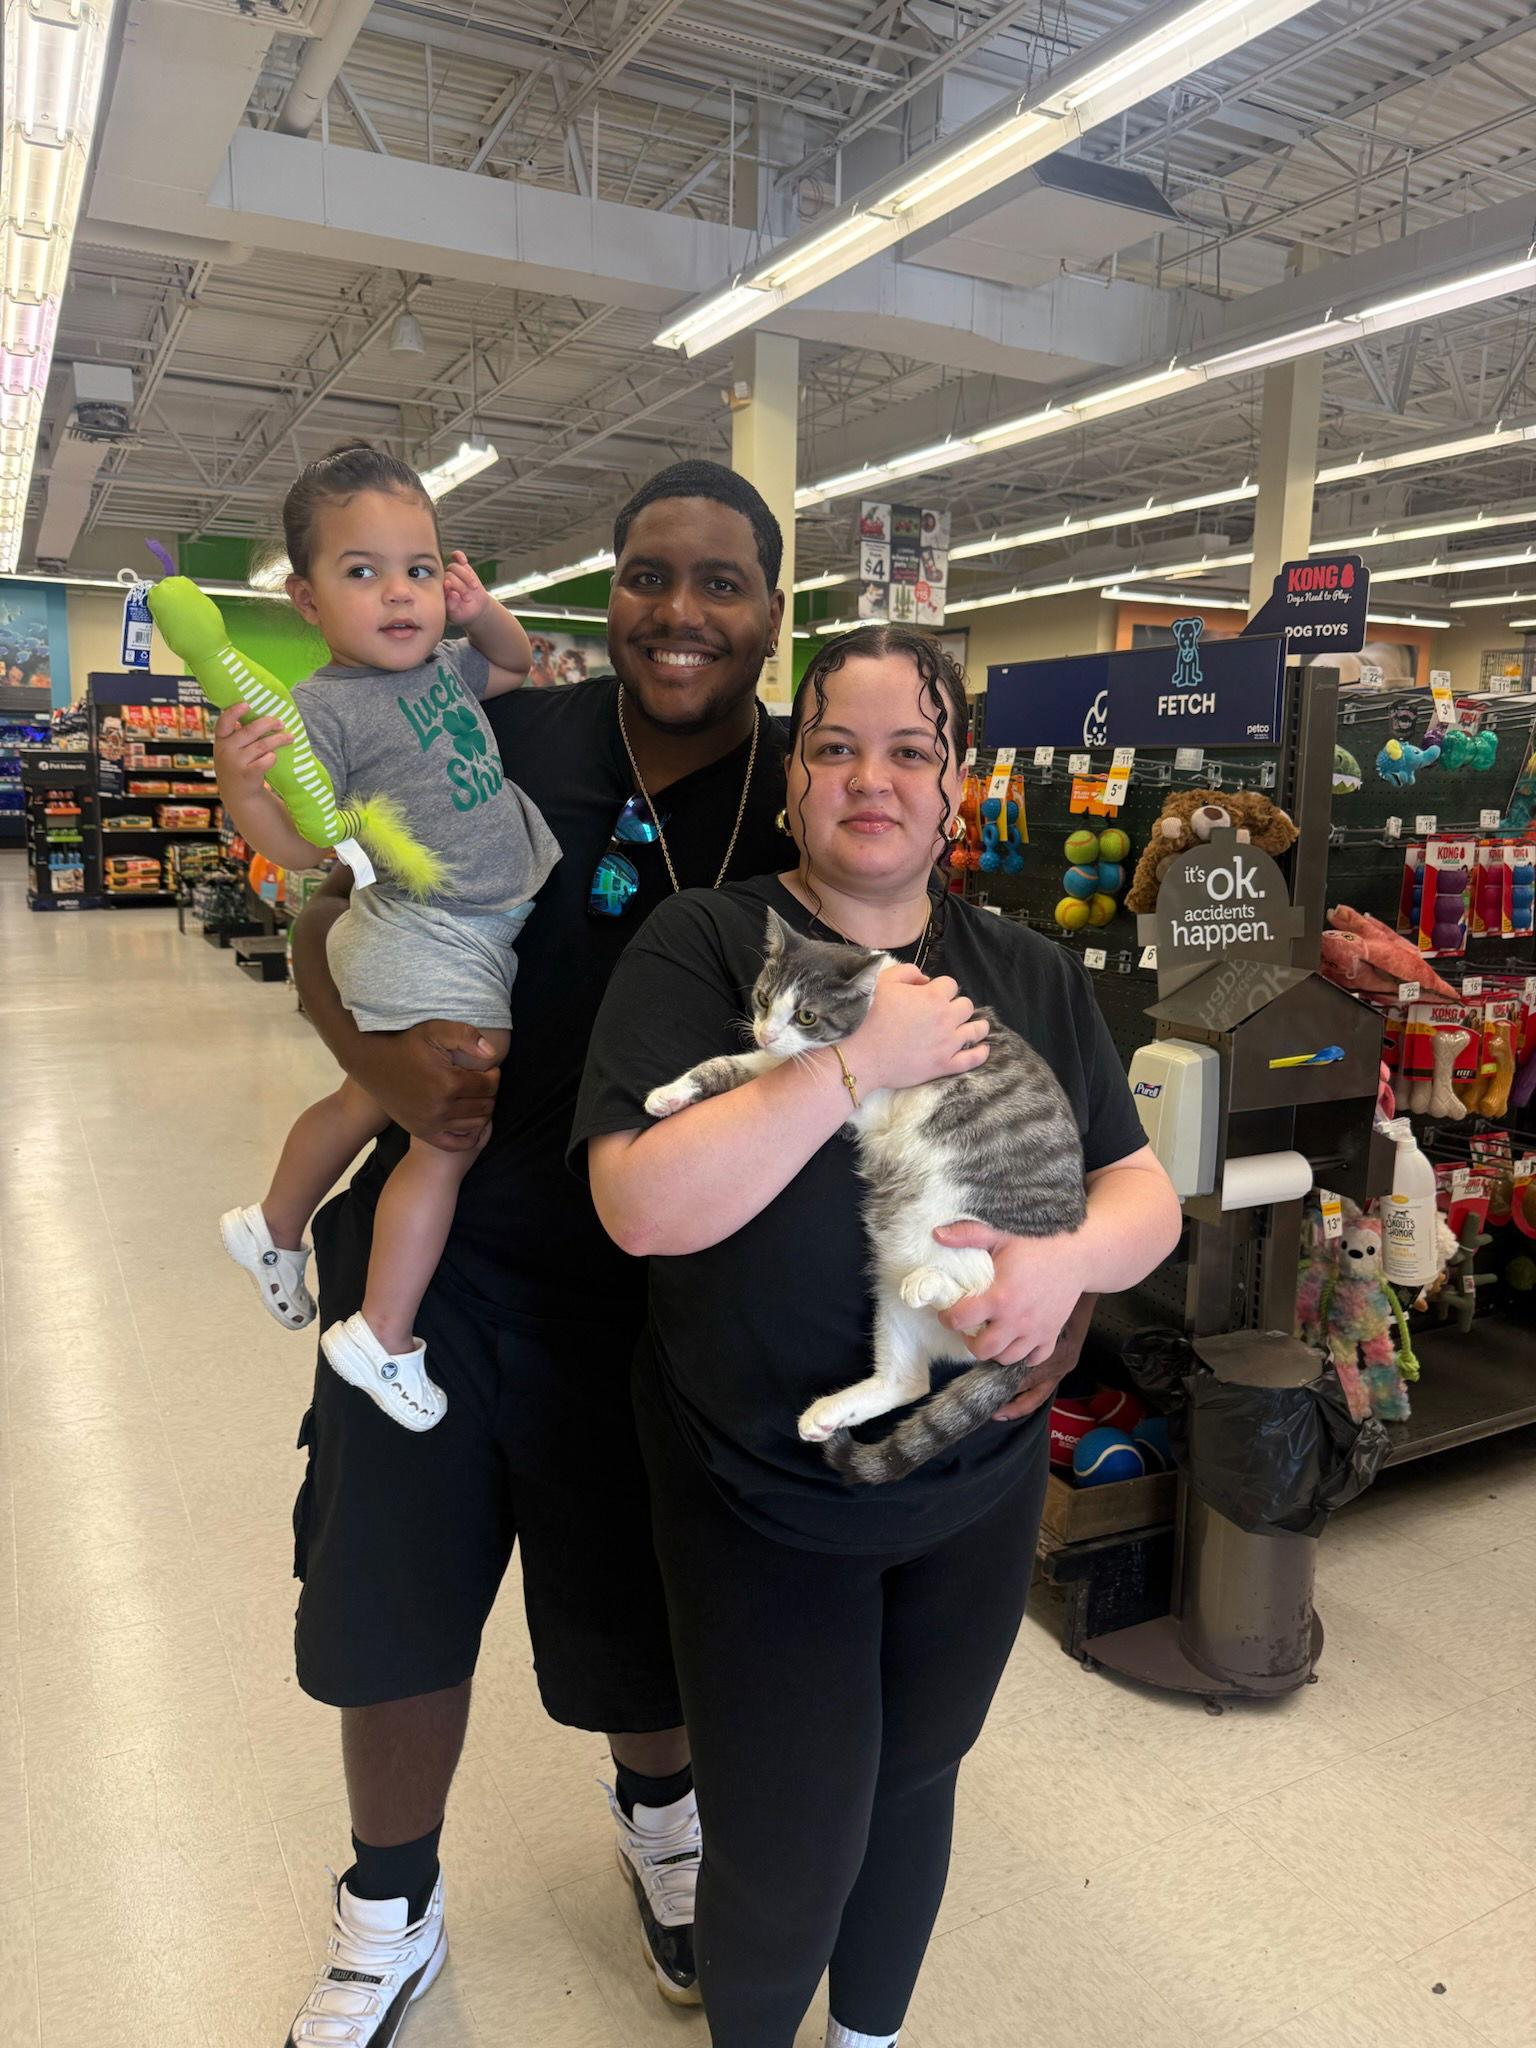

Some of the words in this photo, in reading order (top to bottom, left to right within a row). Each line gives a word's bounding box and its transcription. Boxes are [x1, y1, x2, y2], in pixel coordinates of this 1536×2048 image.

[1288, 565, 1338, 592] KONG
[1286, 593, 1304, 607] Dogs
[1305, 591, 1323, 602] Need
[1324, 592, 1332, 600] to
[1285, 625, 1312, 637] DOG
[1315, 623, 1348, 637] TOYS
[1158, 692, 1216, 716] FETCH
[1247, 724, 1269, 735] petco
[447, 755, 503, 812] Shi
[1437, 846, 1459, 860] KONG
[1184, 865, 1206, 883] it's
[1206, 855, 1265, 901] ok.
[1184, 904, 1255, 922] accidents
[1171, 920, 1275, 952] happen.
[1432, 1008, 1459, 1019] KONG
[1137, 1083, 1159, 1097] Purell
